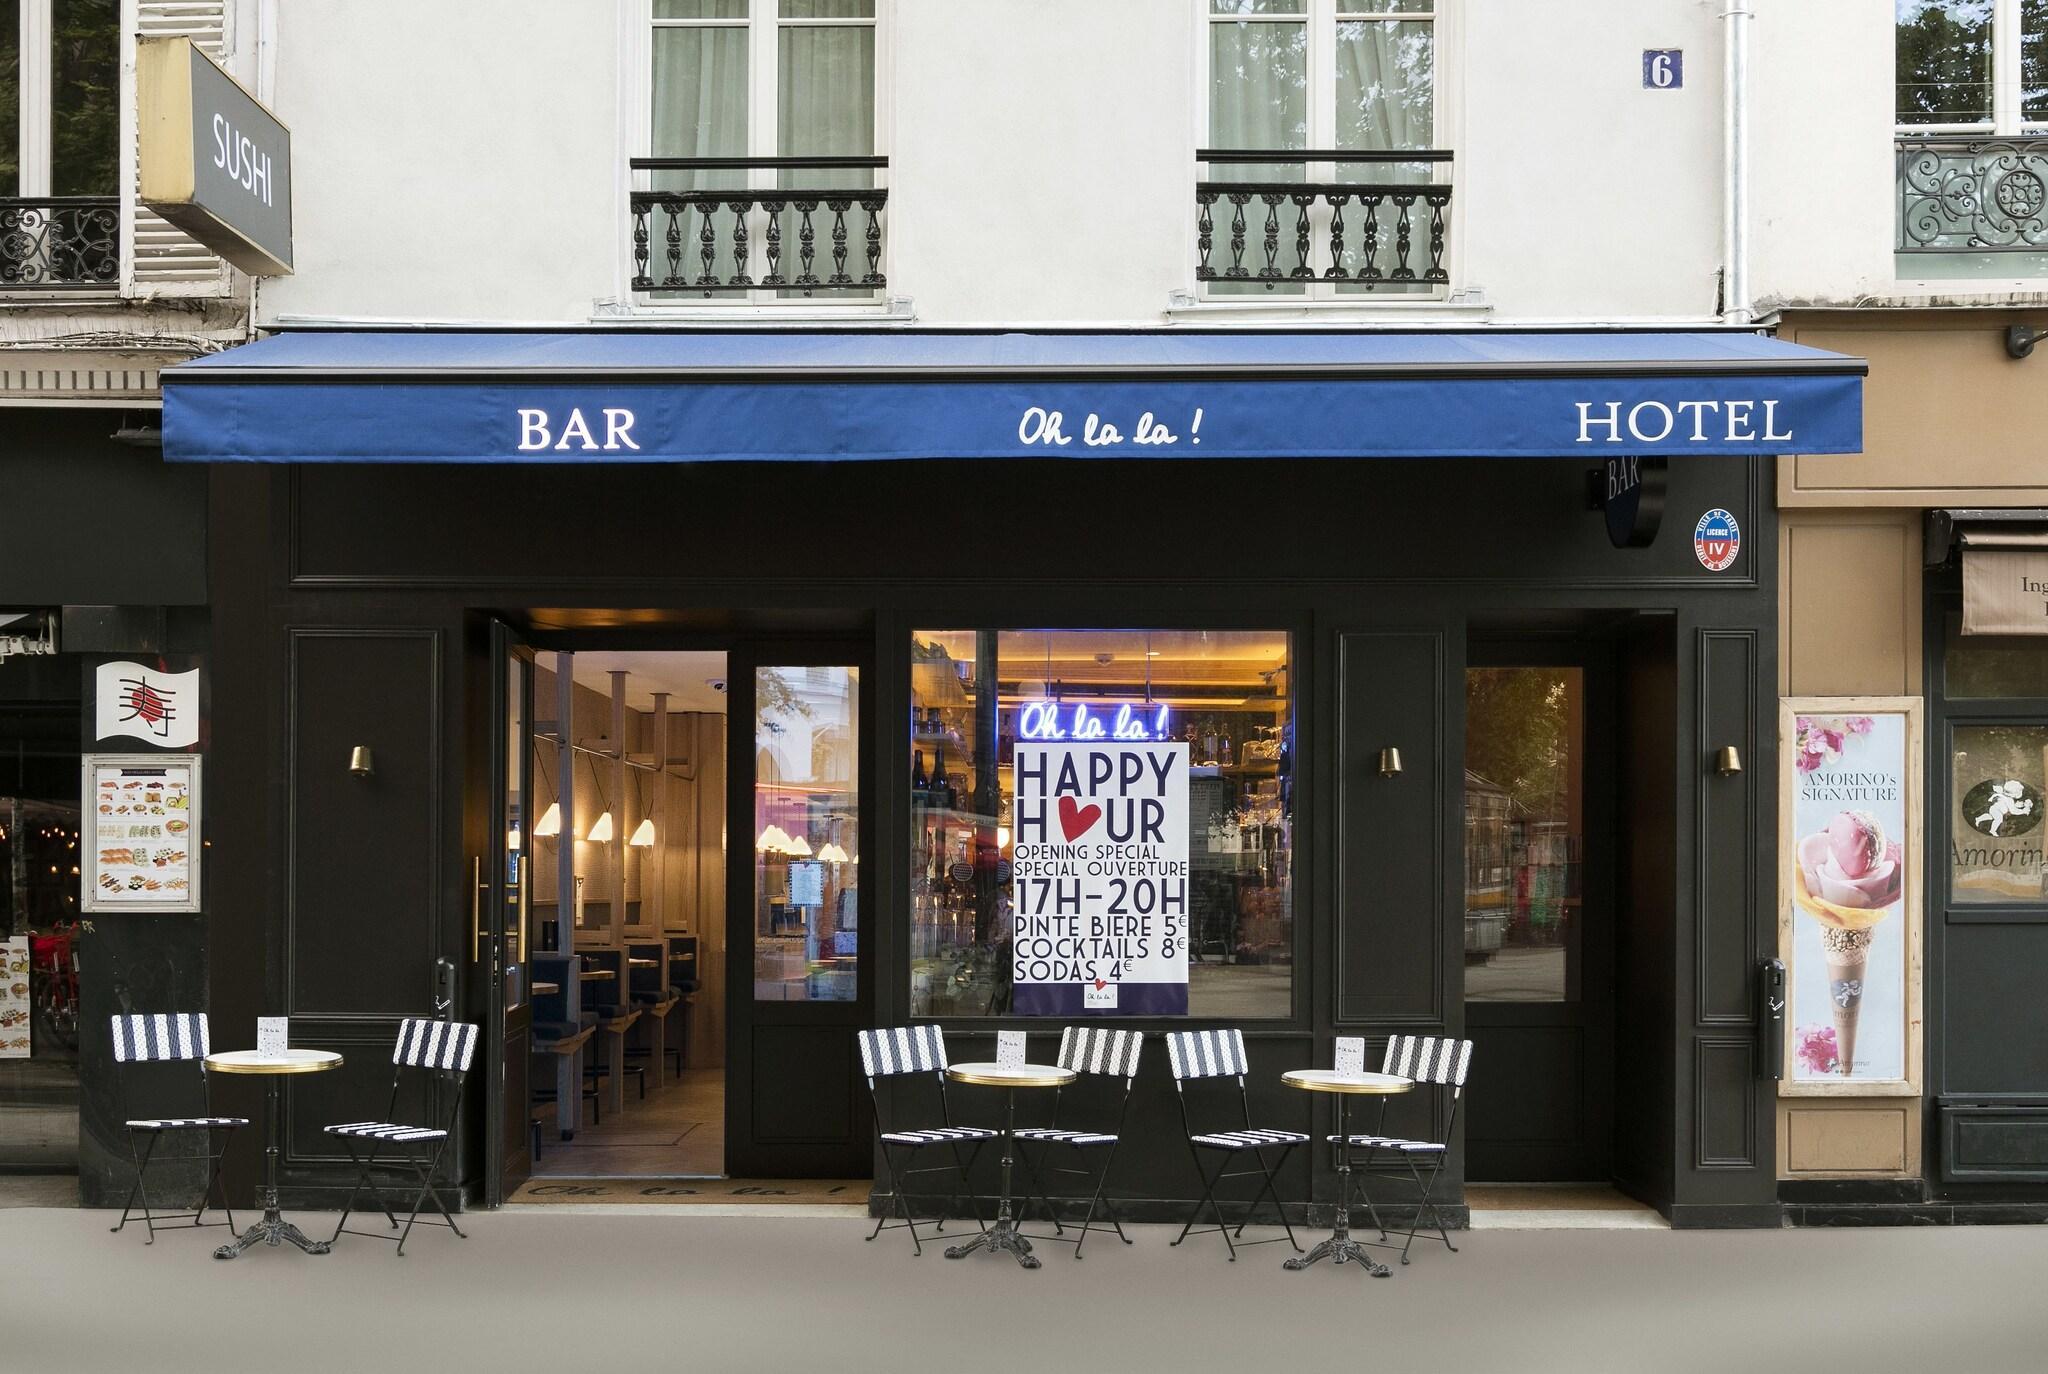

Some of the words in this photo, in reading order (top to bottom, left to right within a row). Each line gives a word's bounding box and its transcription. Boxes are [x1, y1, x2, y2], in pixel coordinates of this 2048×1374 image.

[1653, 54, 1673, 87] 6
[213, 113, 272, 208] SUSHI
[517, 408, 640, 450] BAR
[1018, 407, 1072, 446] Oh
[1083, 413, 1124, 446] la
[1575, 401, 1793, 442] HOTEL
[1607, 456, 1640, 501] BAR
[1697, 515, 1711, 532] VILLE
[1724, 514, 1738, 532] PARIS
[1706, 528, 1728, 536] LICENCE
[1708, 542, 1725, 555] IV
[1020, 703, 1065, 739] Oh
[1071, 703, 1106, 738] la
[1017, 752, 1177, 797] HAPPY
[1805, 773, 1896, 786] AMORINO's
[1801, 788, 1897, 801] SIGNATURE
[1015, 845, 1088, 859] OPENING
[1096, 845, 1160, 859] SPECIAL
[1951, 838, 2048, 867] Amorin
[1015, 862, 1079, 876] SPECIAL
[1087, 862, 1187, 876] OUVERTURE
[1015, 916, 1079, 936] PINTE
[1091, 916, 1151, 936] BIERE
[1015, 938, 1149, 959] COCKTAILS
[1015, 960, 1097, 981] SODAS
[527, 1185, 613, 1197] Oh
[639, 1186, 705, 1196] la
